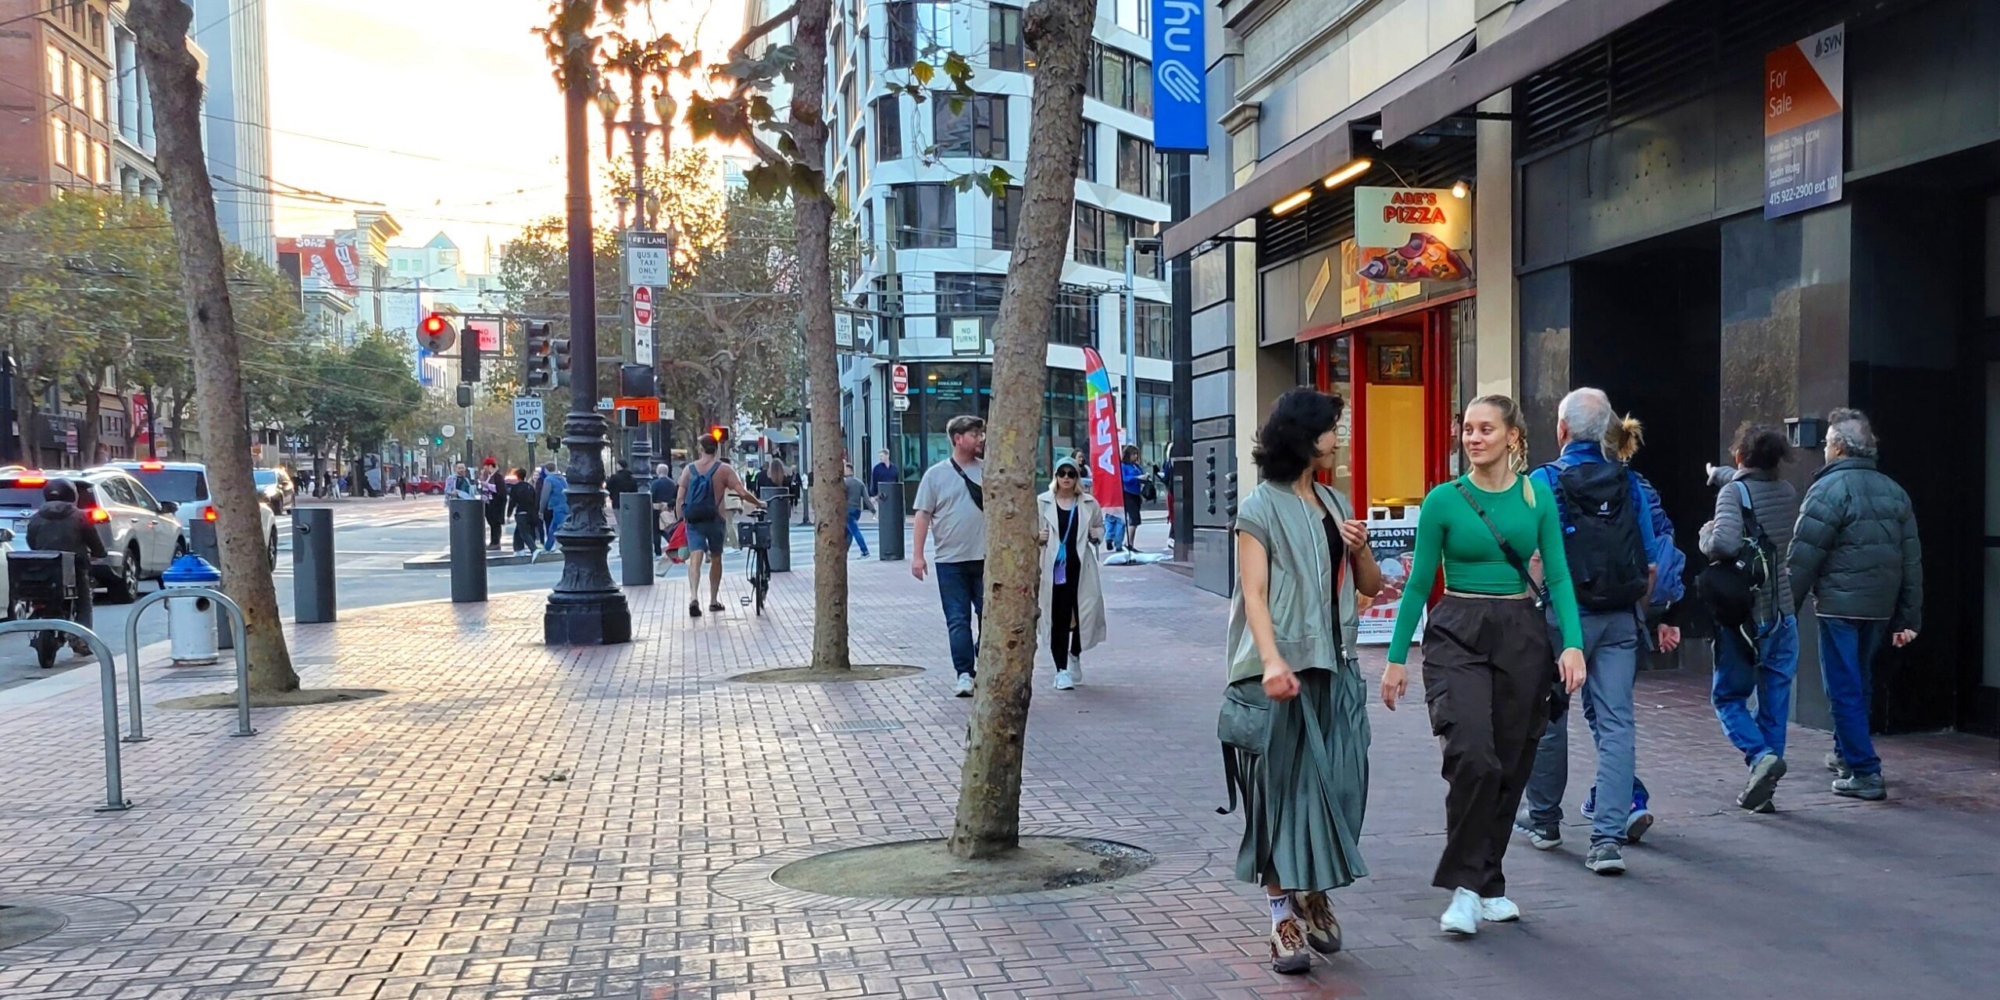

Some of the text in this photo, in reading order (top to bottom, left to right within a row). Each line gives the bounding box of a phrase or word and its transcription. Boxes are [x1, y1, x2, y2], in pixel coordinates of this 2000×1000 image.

[1824, 32, 1842, 53] SVN
[1770, 70, 1787, 91] For
[1769, 93, 1792, 118] Sale
[1769, 175, 1838, 206] 415 922-2900 ext 101
[1391, 191, 1437, 206] ABE'S
[1383, 205, 1446, 224] PIZZA
[647, 237, 667, 245] LANE
[837, 324, 850, 332] LEFT
[481, 336, 497, 344] RNS
[837, 331, 851, 339] TURN
[956, 335, 977, 343] TURNS
[515, 400, 541, 408] SPEED
[517, 417, 542, 431] 20
[1095, 391, 1115, 475] ART
[1367, 529, 1415, 538] PERONI
[1369, 539, 1407, 548] ECIAL
